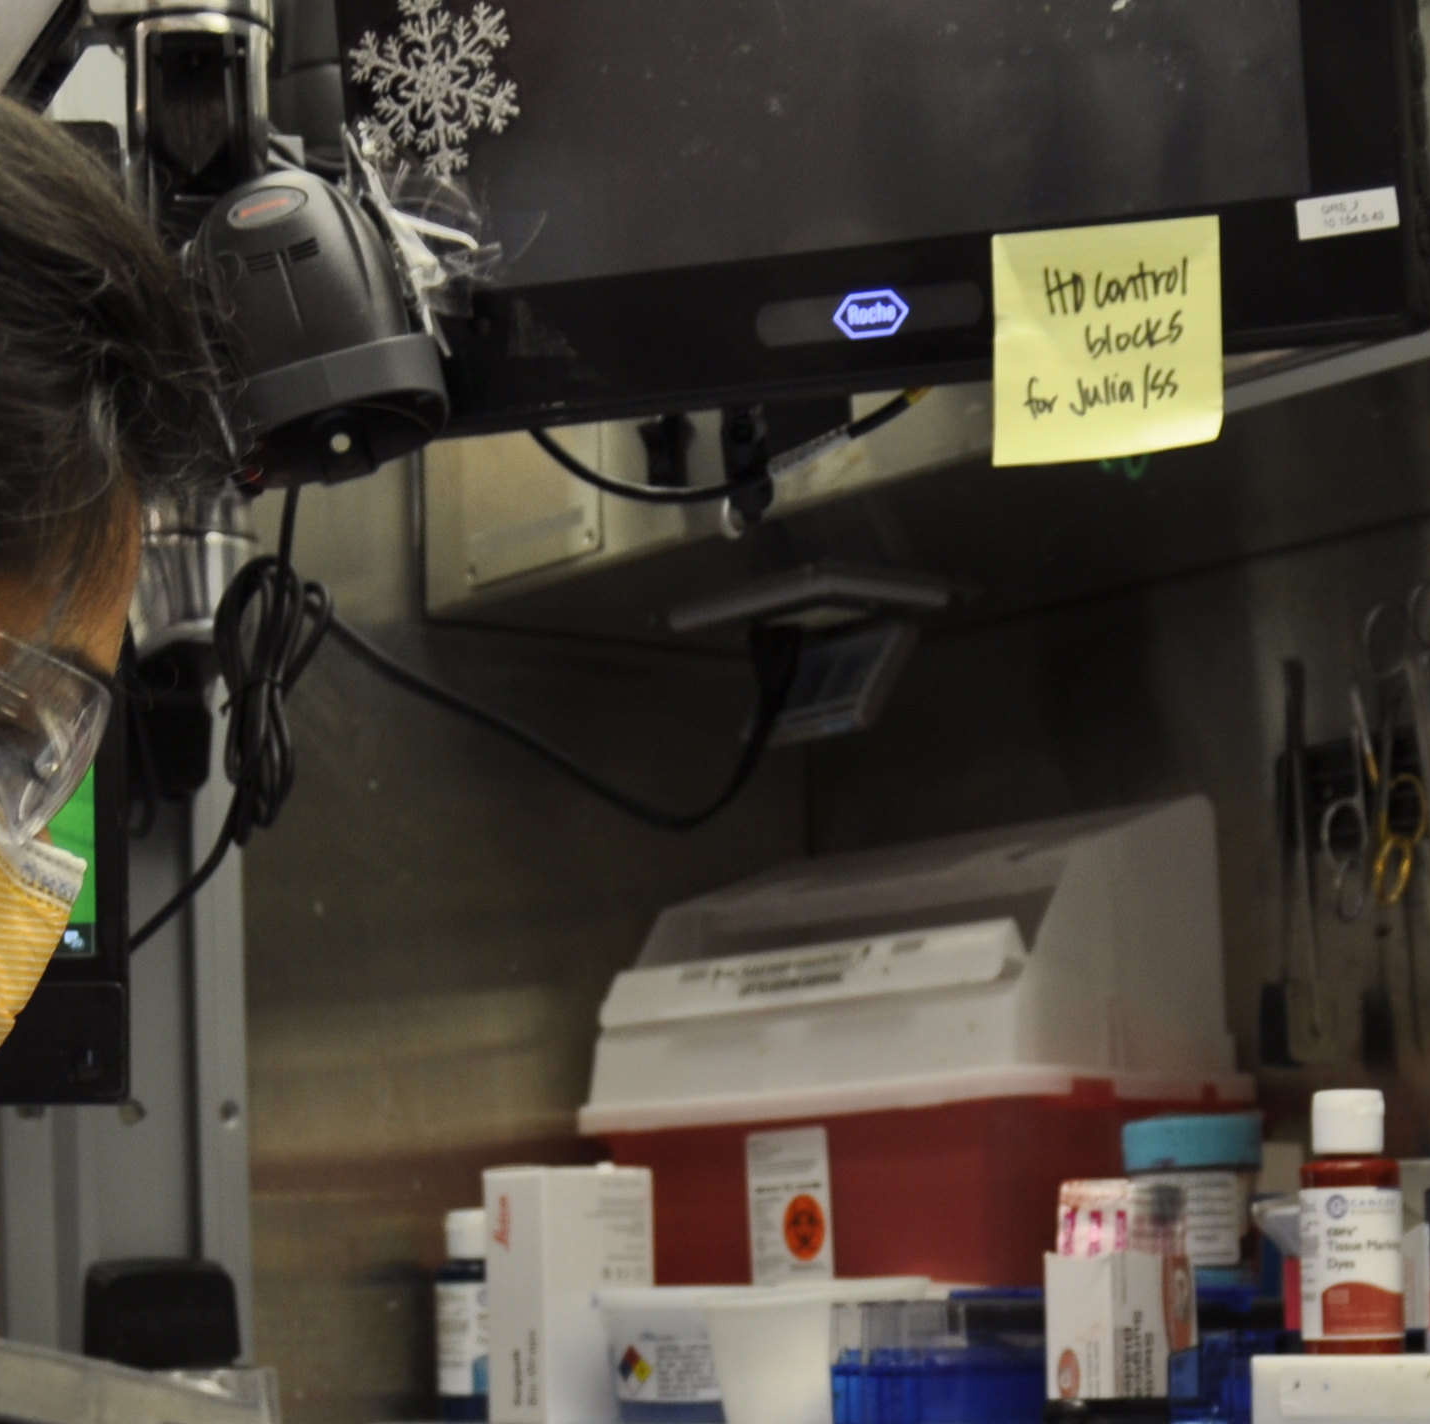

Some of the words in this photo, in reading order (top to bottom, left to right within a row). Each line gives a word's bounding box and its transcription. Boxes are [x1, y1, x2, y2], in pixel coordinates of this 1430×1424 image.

[847, 301, 897, 326] Roche
[1085, 309, 1183, 359] blocks
[1024, 376, 1058, 420] for
[1327, 1240, 1363, 1252] Tissue
[1327, 1258, 1356, 1271] Dyes
